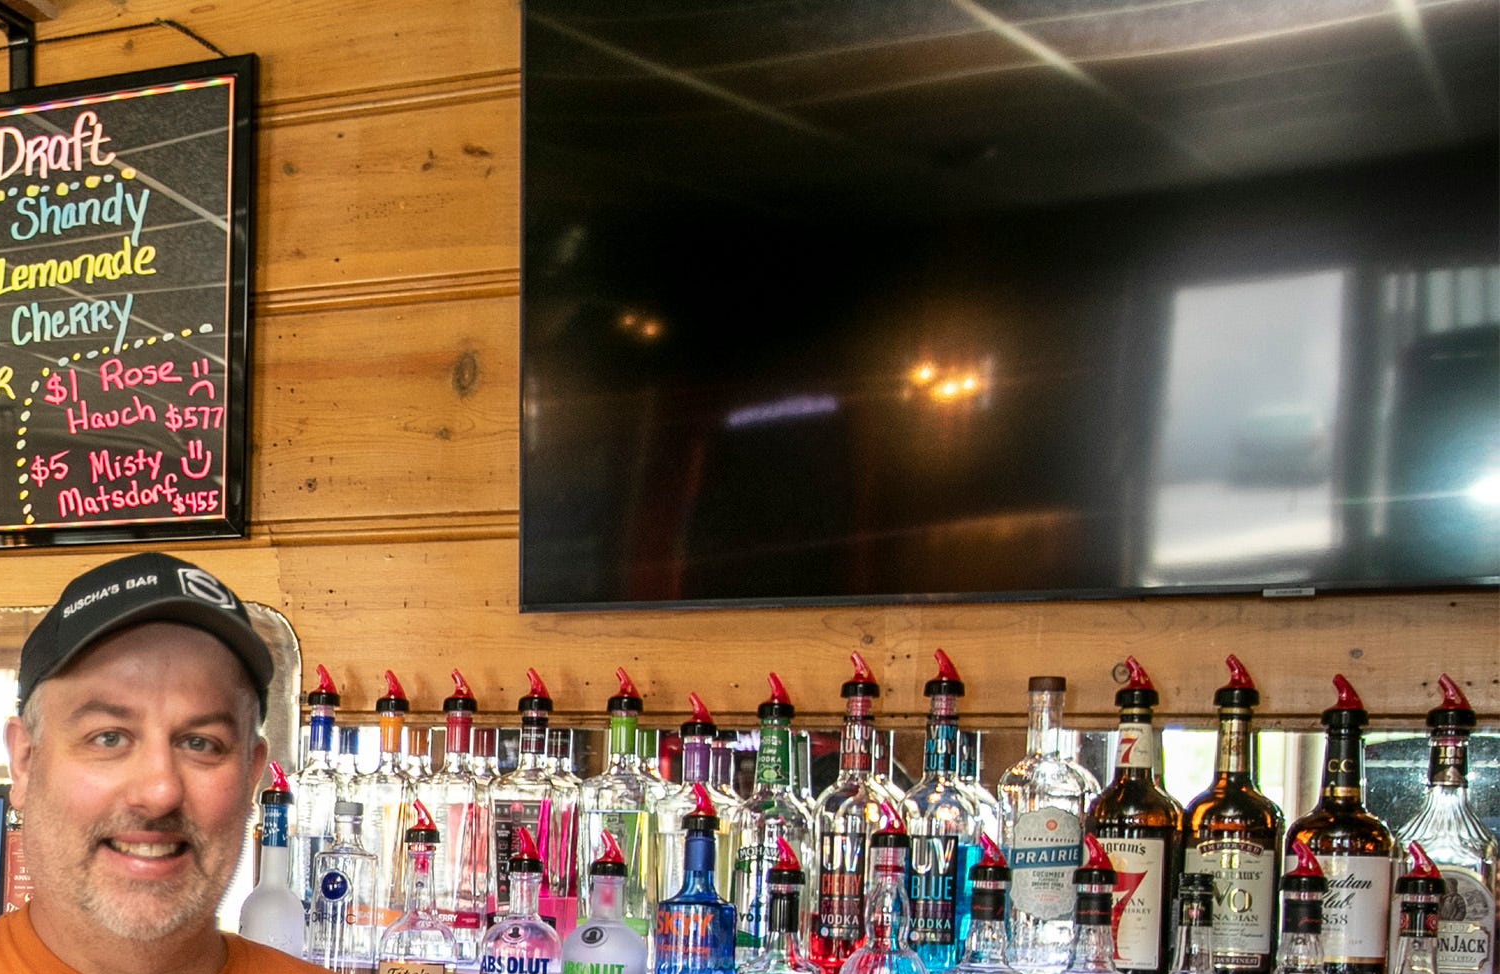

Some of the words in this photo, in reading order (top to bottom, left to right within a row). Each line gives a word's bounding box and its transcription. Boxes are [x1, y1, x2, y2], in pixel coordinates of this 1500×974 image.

[10, 184, 150, 246] Shandy
[11, 294, 134, 355] Cherry
[44, 371, 78, 405] $1
[99, 359, 183, 393] Rose
[67, 403, 156, 434] Hauch
[165, 406, 224, 431] $577
[30, 450, 70, 488] $5
[90, 449, 162, 485] Misty
[59, 475, 177, 517] Matsdorf
[172, 489, 219, 512] $455
[63, 584, 119, 618] SUSCHA'S
[126, 575, 157, 589] BAR
[1120, 738, 1137, 763] 7
[739, 847, 780, 859] MOHAW
[822, 836, 860, 872] UV
[912, 838, 955, 874] UV
[1015, 848, 1079, 864] PRAIRIE
[1101, 842, 1146, 855] agram's
[1203, 842, 1260, 854] IMPORTED
[822, 874, 861, 896] CHERRY
[911, 877, 953, 900] BLUE
[1327, 873, 1372, 890] adian
[657, 911, 714, 936] SKYY
[821, 914, 859, 925] VODKA
[911, 918, 951, 928] VODKA
[1449, 936, 1485, 953] JACK
[481, 955, 549, 974] ABSOLUT
